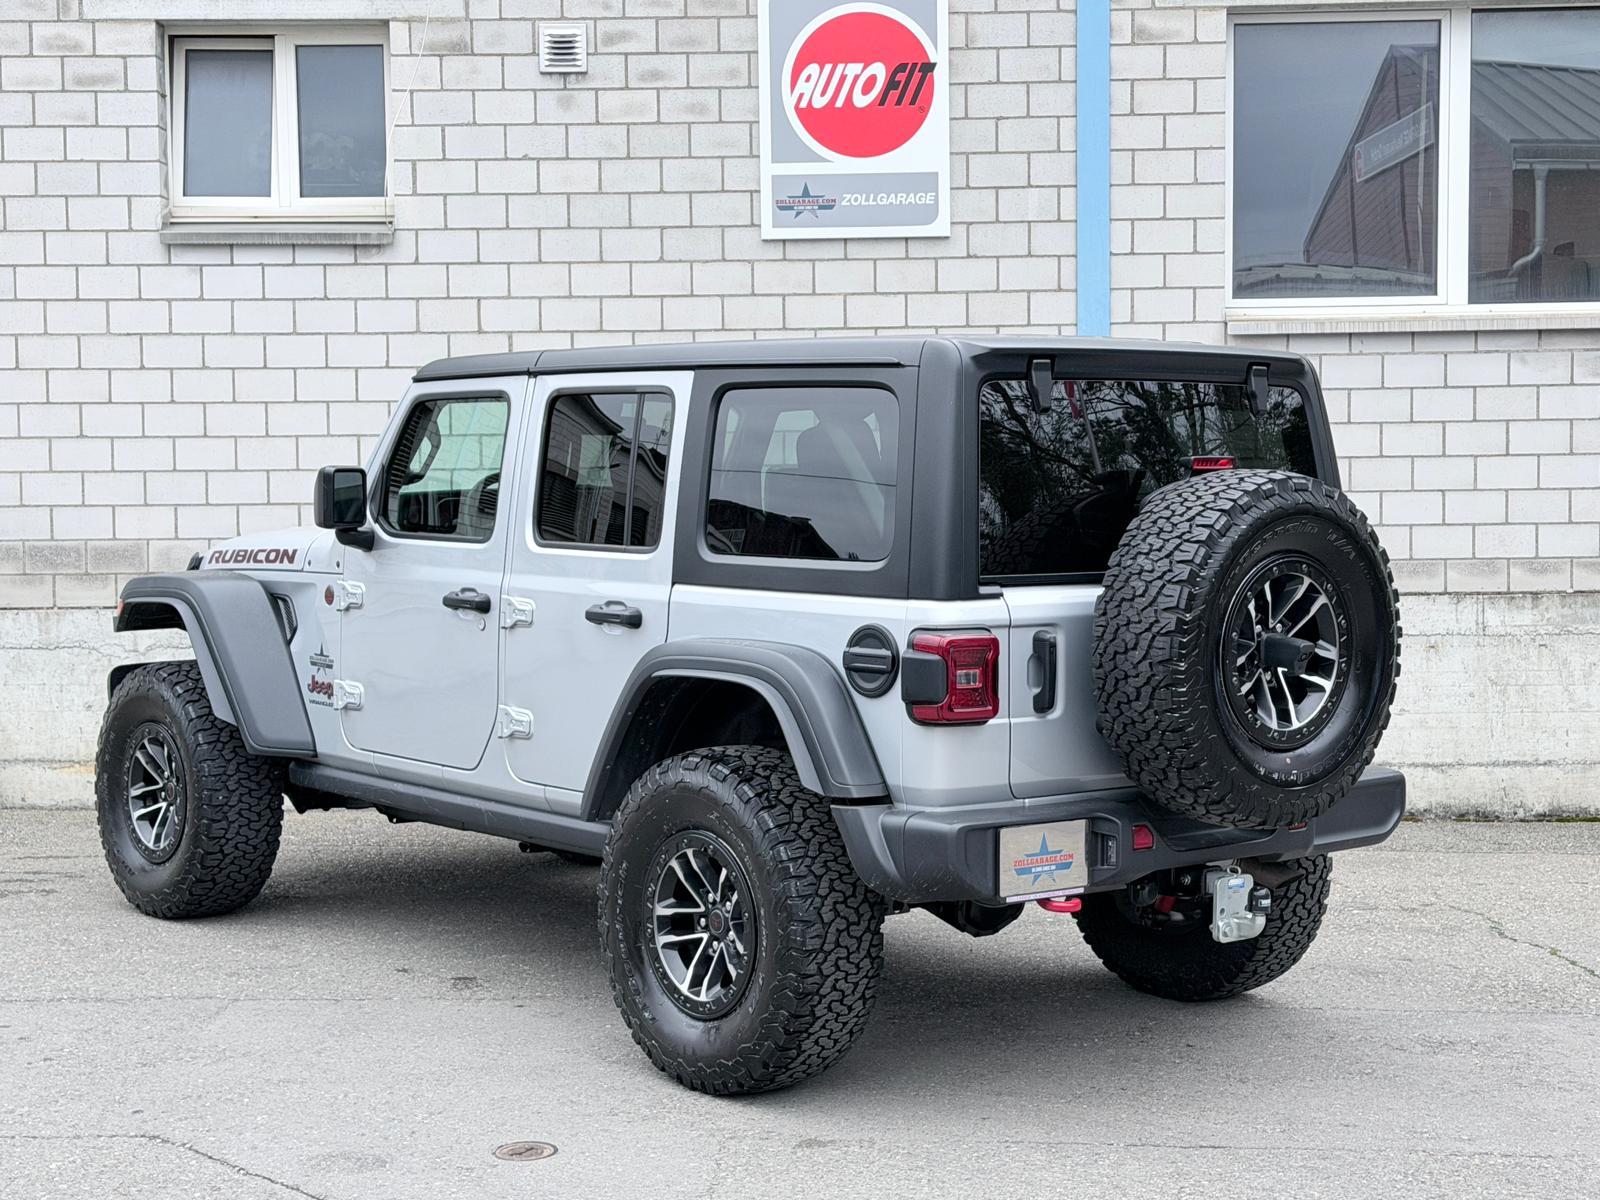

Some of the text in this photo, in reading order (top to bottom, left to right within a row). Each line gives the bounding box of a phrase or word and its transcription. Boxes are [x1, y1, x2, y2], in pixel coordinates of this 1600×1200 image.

[791, 62, 938, 109] AUTOFIT
[841, 192, 936, 206] ZOLLGARAGE
[208, 548, 298, 565] RUBICON
[308, 674, 334, 699] Jeep
[1013, 853, 1074, 868] ZOLLGARAGE.COM
